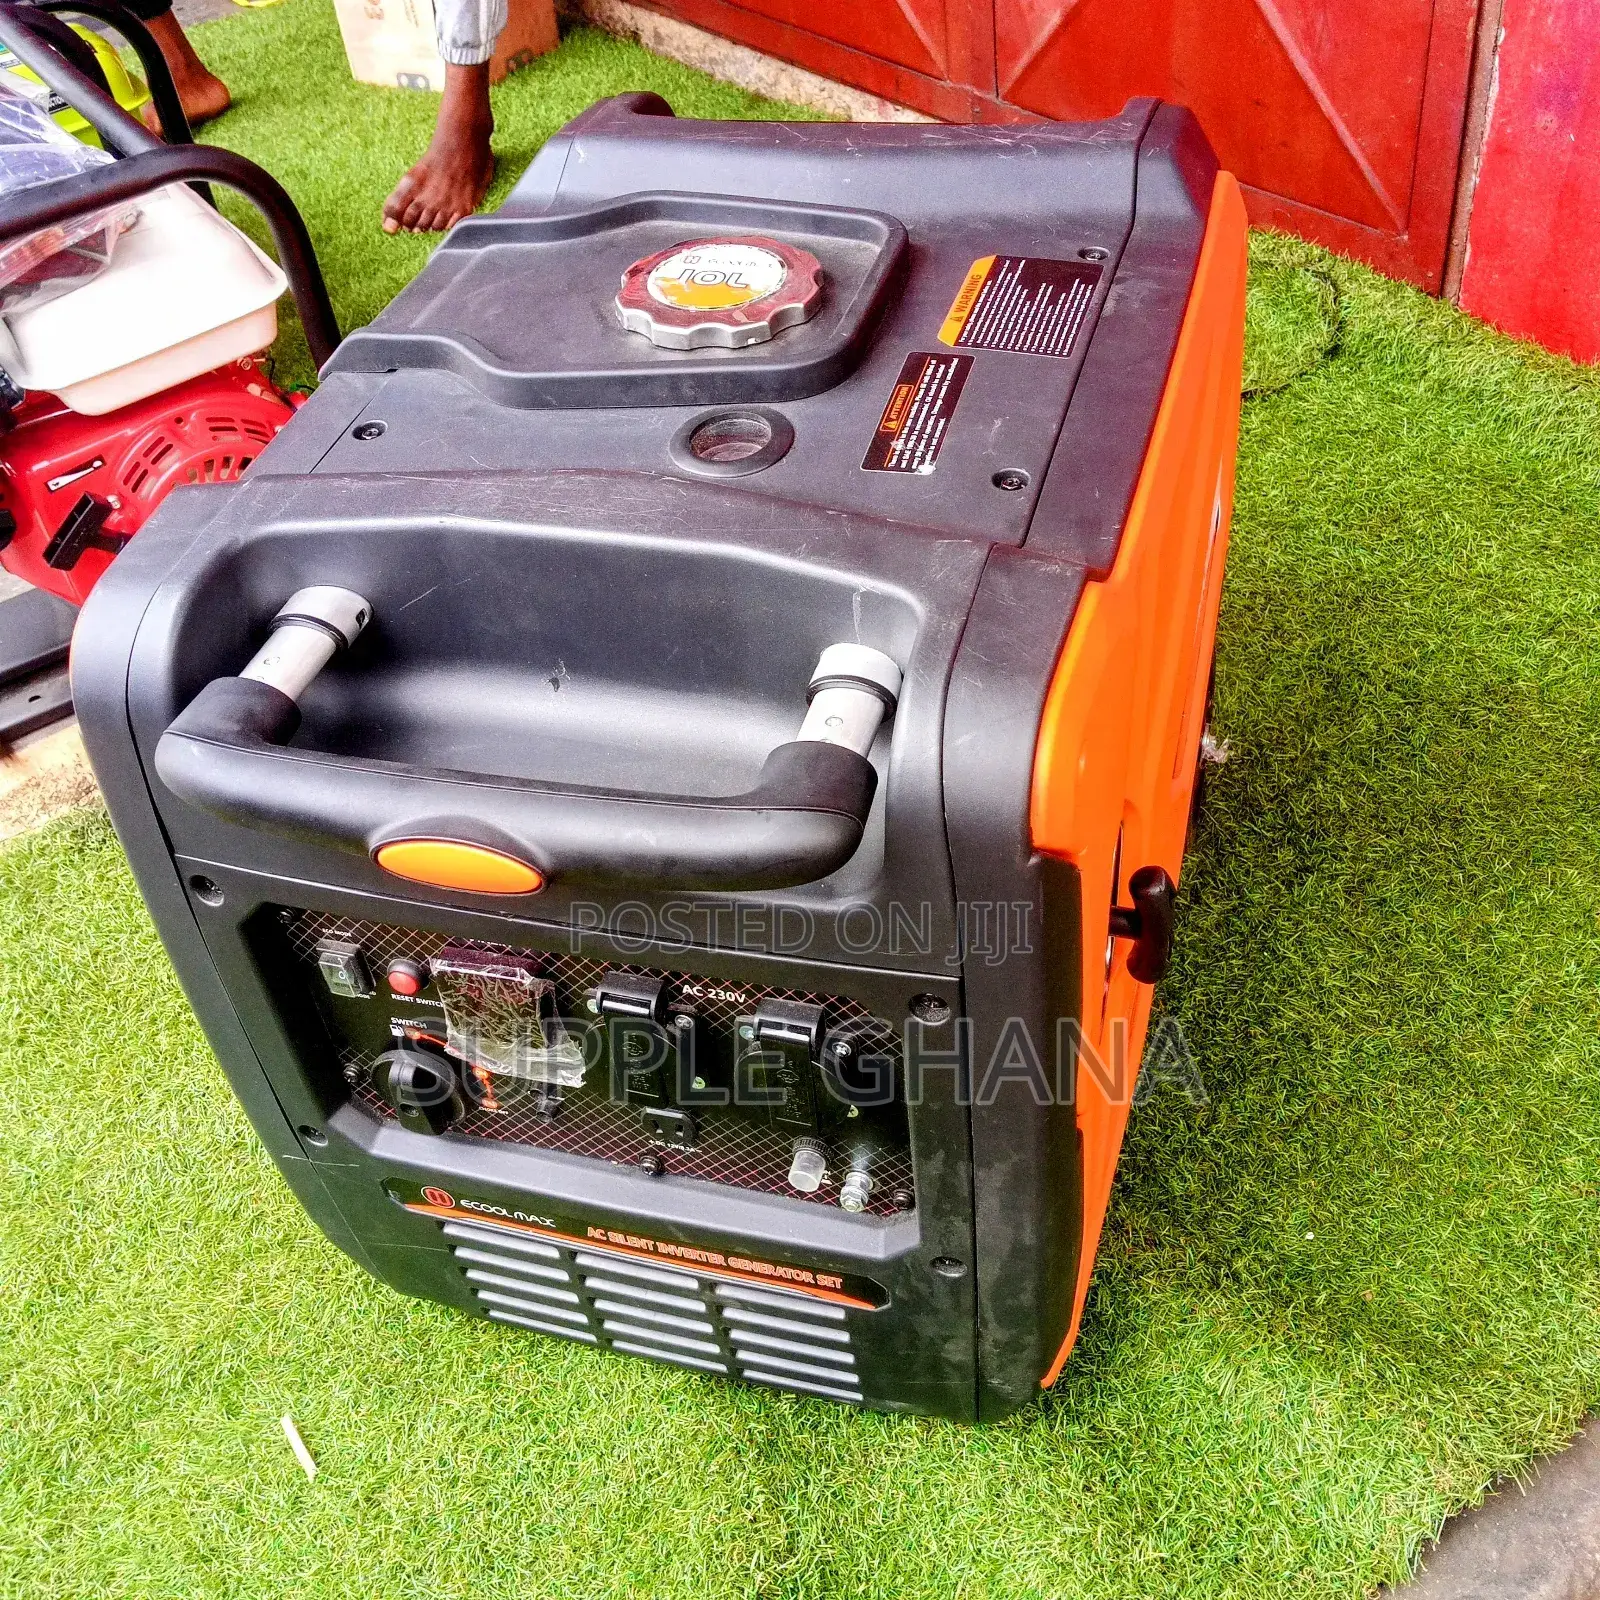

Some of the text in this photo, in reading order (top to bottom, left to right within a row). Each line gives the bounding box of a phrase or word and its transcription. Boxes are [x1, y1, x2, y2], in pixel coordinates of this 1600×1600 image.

[954, 272, 983, 311] WARNING
[889, 385, 910, 420] ATTENTION
[390, 993, 414, 1003] RESET
[682, 983, 747, 1004] AC 230V
[390, 1017, 428, 1030] SWITCH
[460, 1198, 556, 1228] ECOOLMAX
[587, 1226, 843, 1290] AC SILENT INVERTER GENERATOR SET
